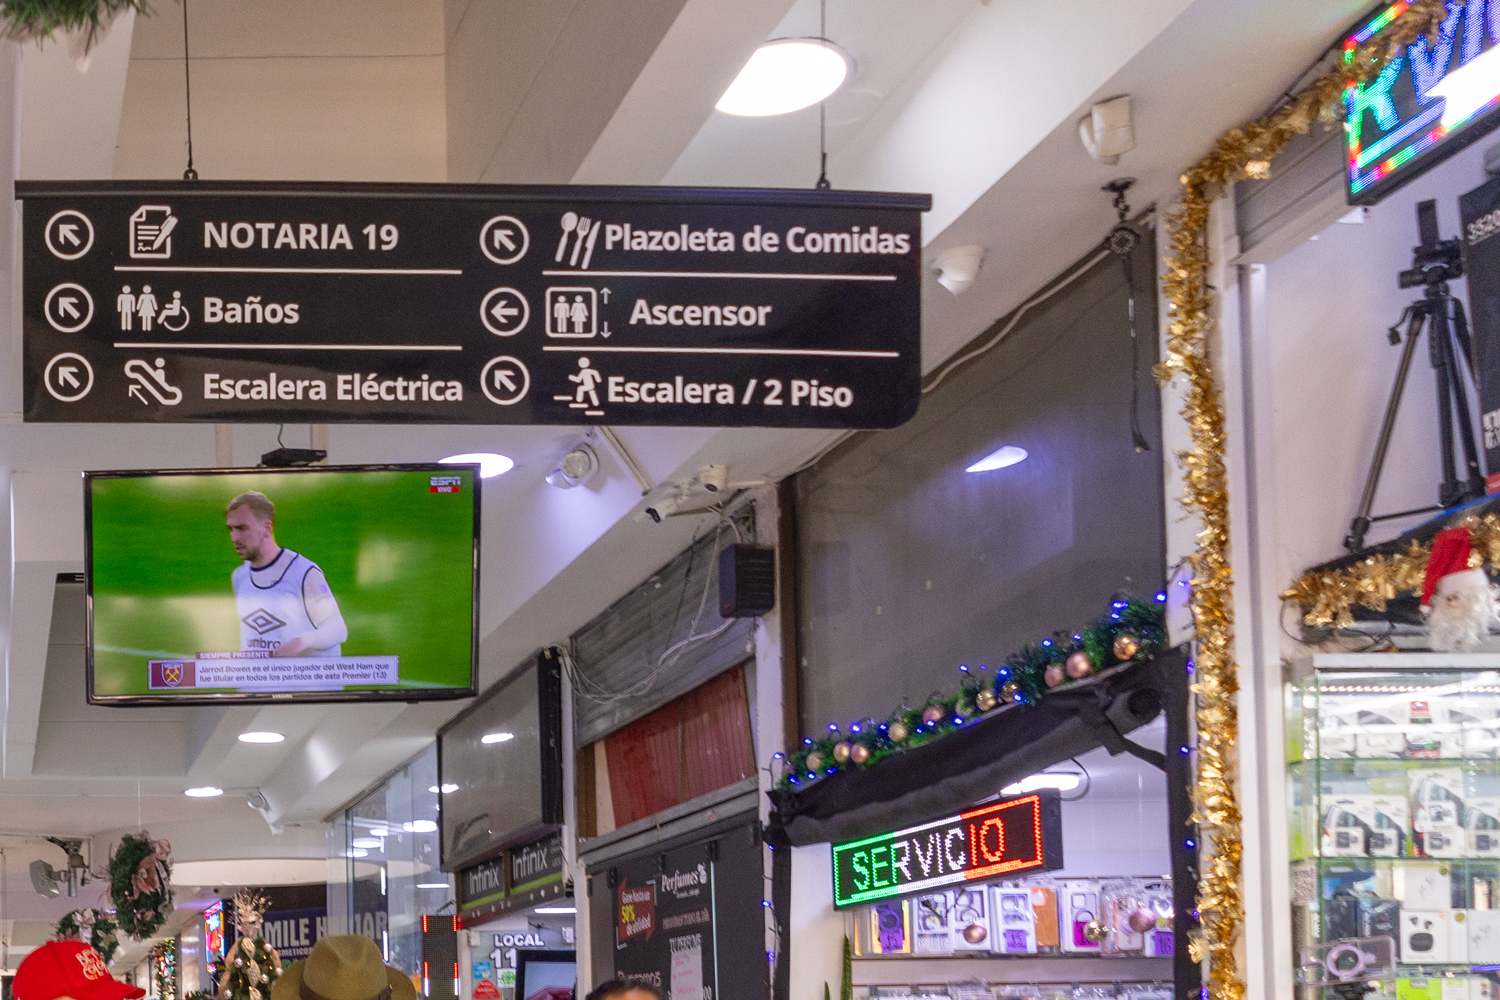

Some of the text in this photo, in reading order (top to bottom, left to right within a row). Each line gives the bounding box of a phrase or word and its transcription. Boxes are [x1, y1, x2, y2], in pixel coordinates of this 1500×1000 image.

[204, 222, 399, 251] NOTARIA 19
[605, 223, 911, 254] Plazoleta de Comidas
[203, 296, 300, 324] Baños
[629, 299, 772, 327] Ascensor
[204, 373, 464, 402] Escalera Eléctrica
[607, 376, 735, 405] Escalera
[763, 379, 784, 406] 2
[791, 380, 854, 408] Piso
[430, 476, 461, 486] ESPN
[199, 665, 224, 674] Jarrod
[225, 665, 251, 673] Bowen
[271, 664, 292, 672] único
[292, 663, 321, 673] jugador
[323, 663, 335, 671] del
[336, 663, 355, 671] West
[375, 663, 389, 671] que
[233, 651, 270, 659] PRESENTE
[213, 674, 234, 682] titular
[282, 673, 312, 682] partidos
[341, 671, 371, 680] Premier
[372, 671, 387, 680] (13)
[512, 842, 548, 882] Infinix
[852, 816, 1005, 892] SERVICIO
[468, 861, 500, 895] Infinix
[661, 869, 699, 895] Perfumes
[493, 933, 545, 948] LOCAL
